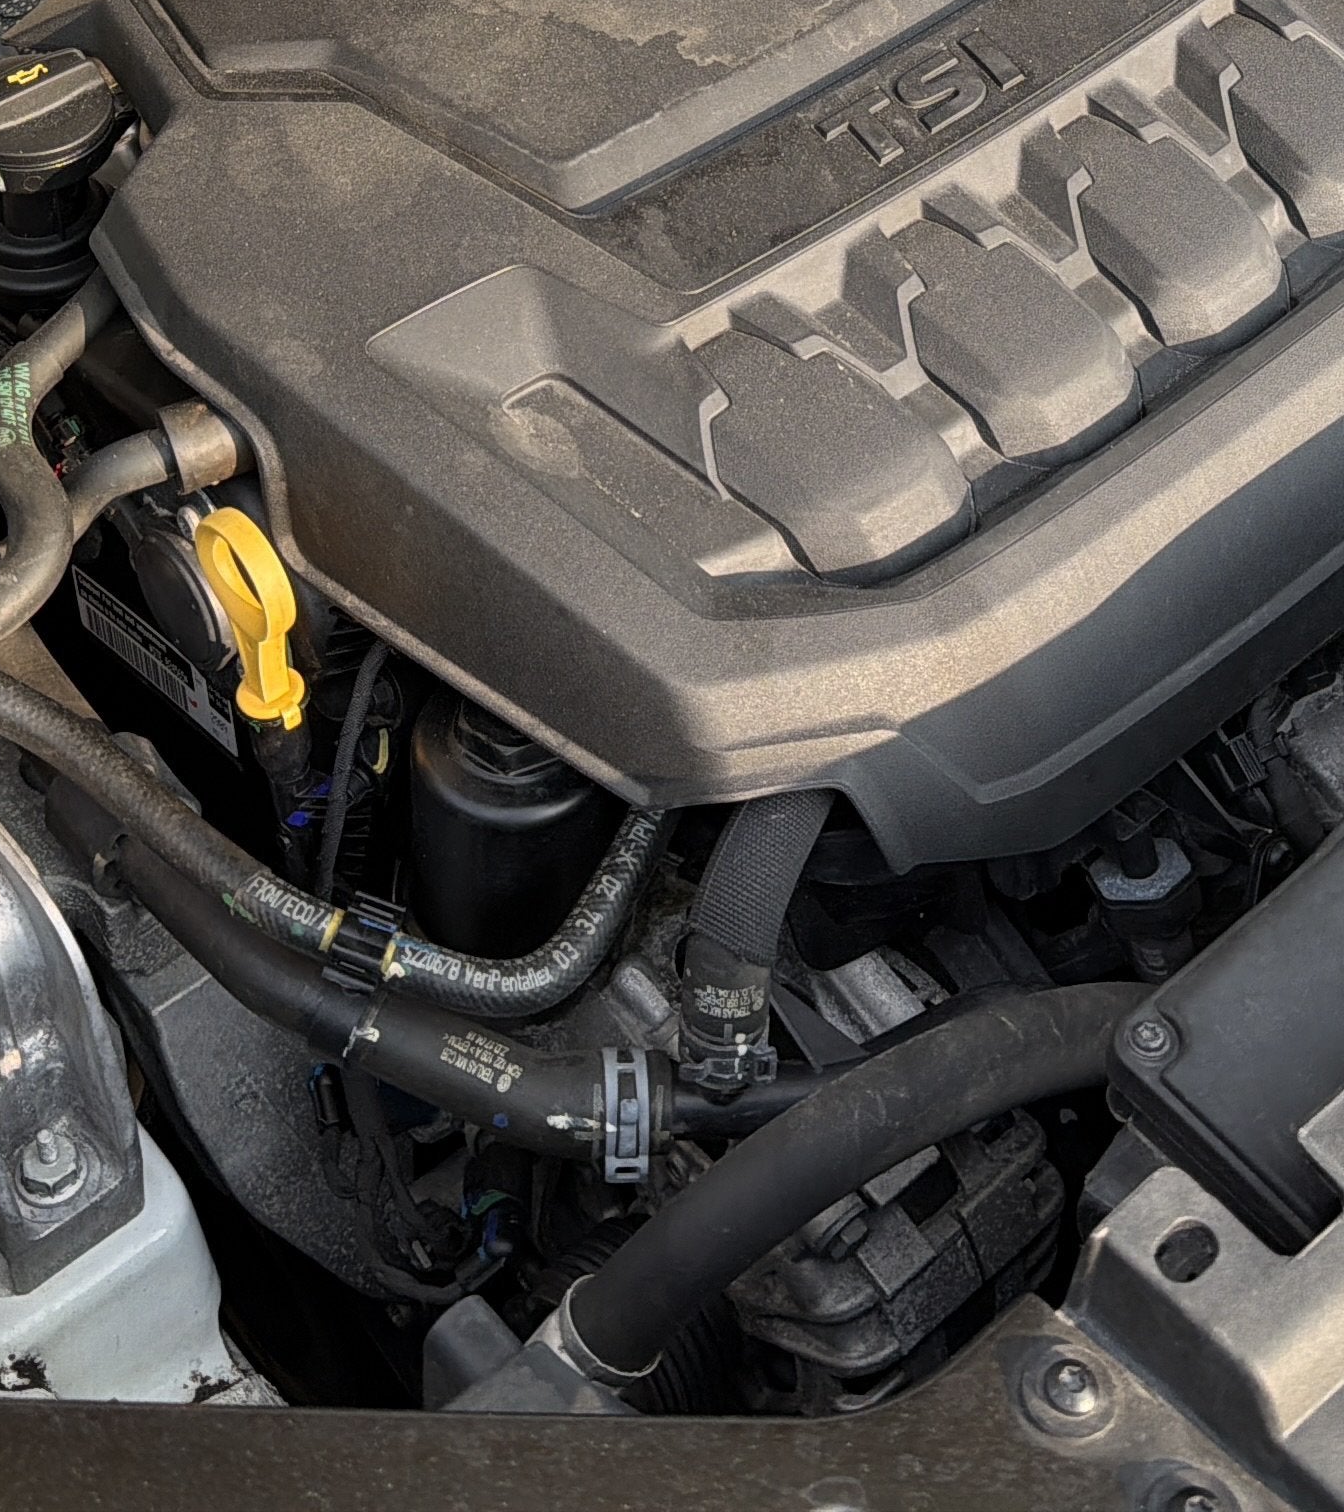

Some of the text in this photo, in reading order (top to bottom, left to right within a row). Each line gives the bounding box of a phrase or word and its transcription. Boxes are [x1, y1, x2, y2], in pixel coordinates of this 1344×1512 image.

[813, 28, 1026, 167] TSI
[464, 962, 556, 994] VeriPentaflex
[552, 941, 581, 970] 03
[596, 874, 623, 902] 20
